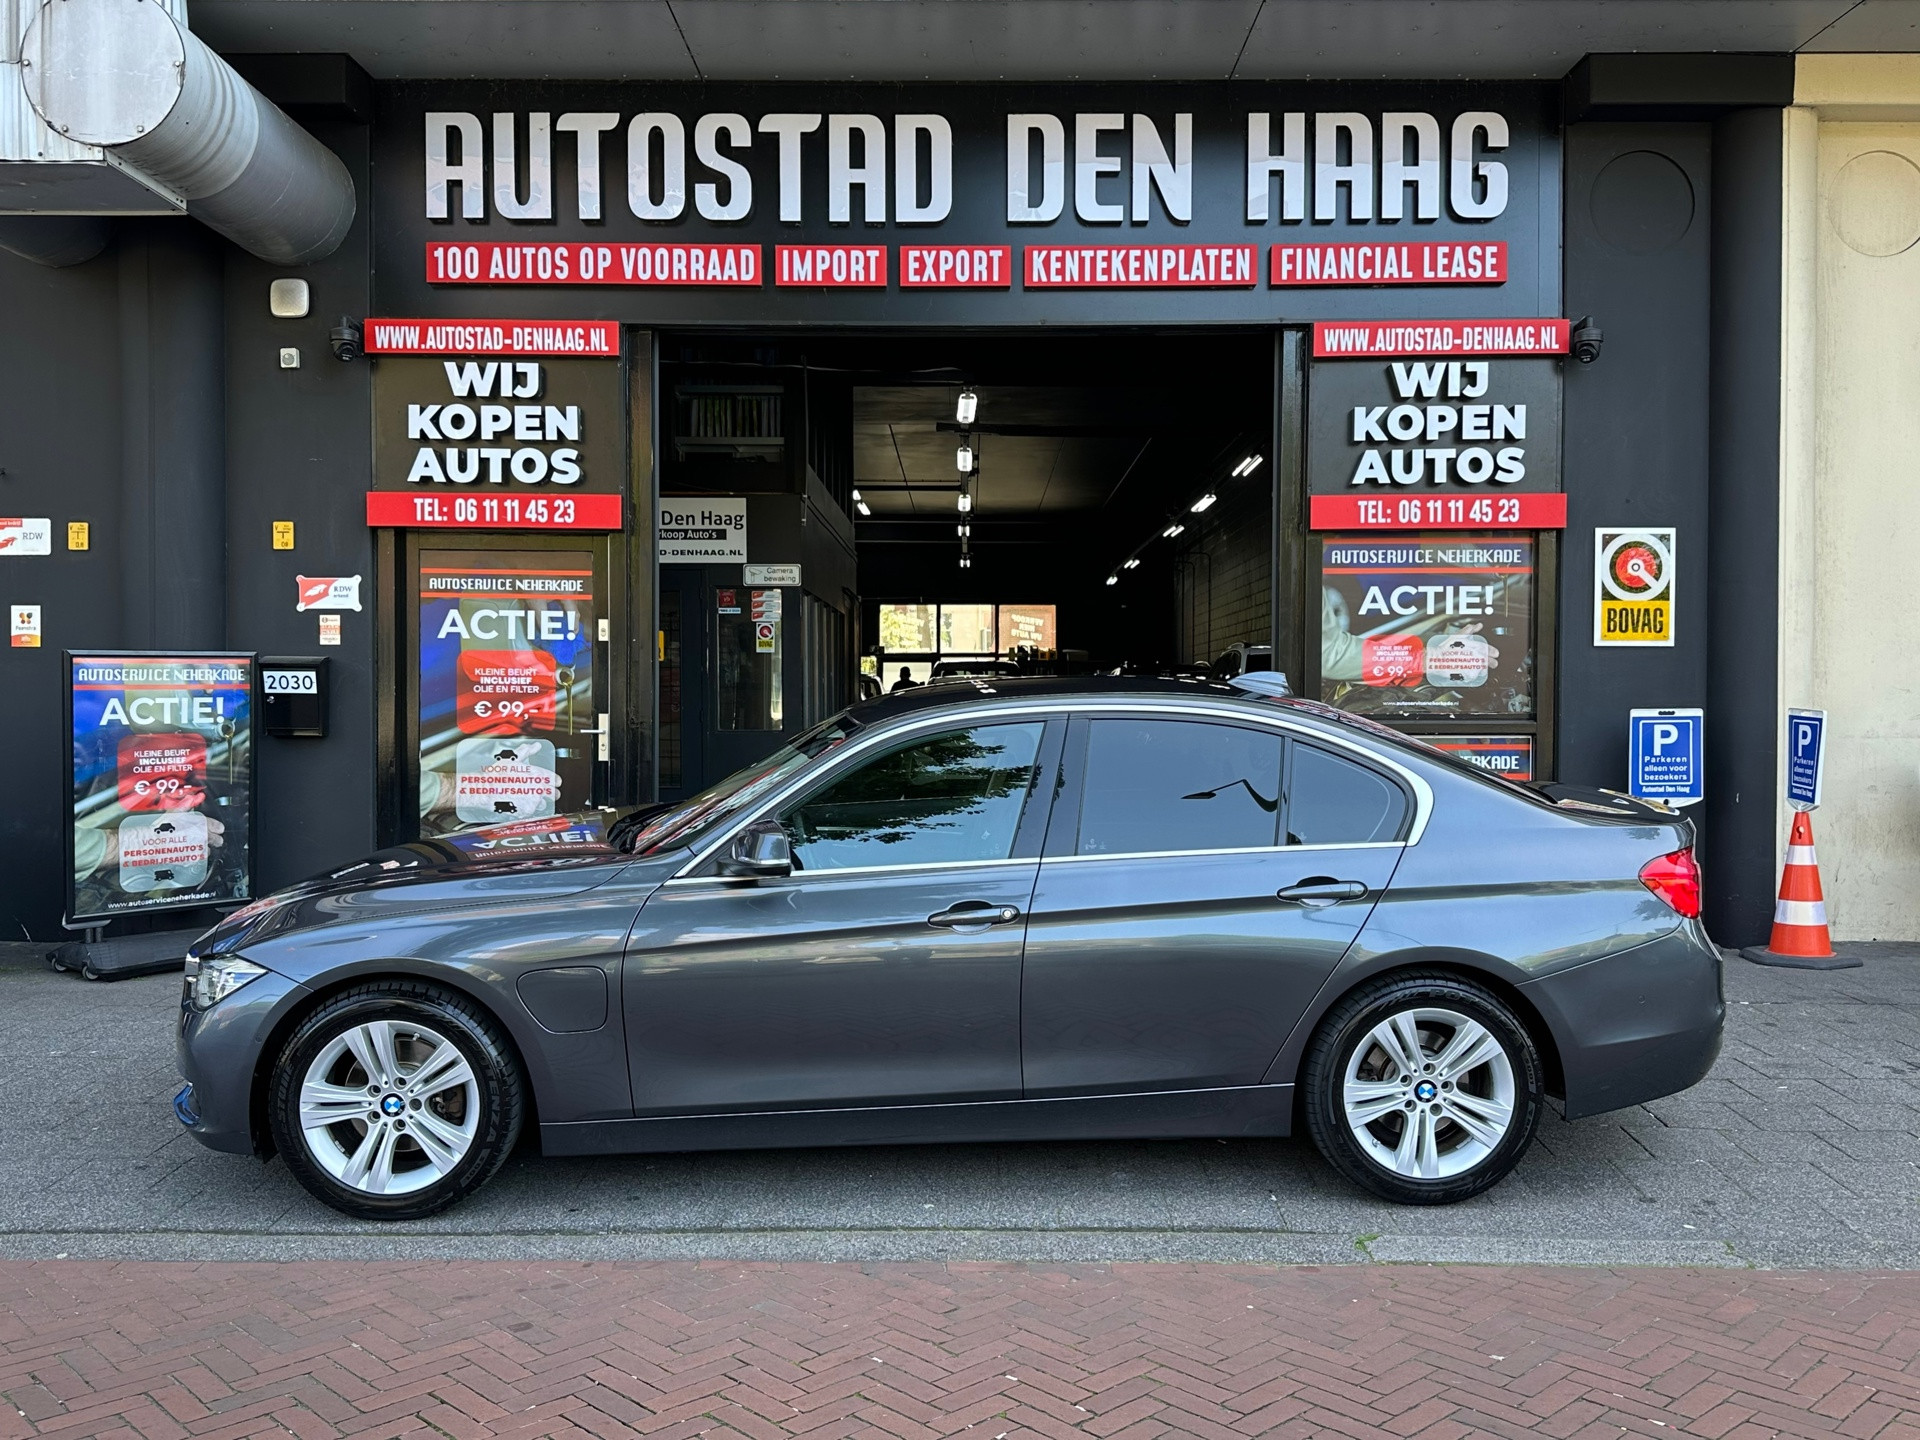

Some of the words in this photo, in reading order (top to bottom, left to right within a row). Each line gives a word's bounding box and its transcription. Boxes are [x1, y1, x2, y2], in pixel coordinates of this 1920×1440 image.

[425, 112, 953, 222] AUTOSTAD
[1007, 112, 1193, 222] DEN
[1246, 111, 1510, 222] HAAG
[433, 248, 480, 279] 100
[489, 248, 570, 280] AUTOS
[580, 248, 613, 280] OP
[621, 249, 756, 282] VOORRAAD
[782, 249, 880, 282] IMPORT
[908, 250, 1003, 283] EXPORT
[1032, 248, 1251, 283] KENTEKENPLATEN
[1281, 247, 1413, 280] FINANCIAL
[1423, 245, 1498, 279] LEASE
[374, 326, 609, 351] WWW.AUTOSTAD-DENHAAG.NL
[1324, 326, 1559, 352] WWW.AUTOSTAD-DENHAAG.NL
[444, 362, 540, 398] WIJ
[1391, 362, 1489, 397] WIJ
[408, 403, 579, 441] KOPEN
[1353, 404, 1527, 441] KOPEN
[407, 447, 581, 484] AUTOS
[1351, 447, 1526, 485] AUTOS
[414, 498, 448, 521] TEL:
[455, 499, 478, 522] 06
[483, 498, 498, 522] 11
[504, 499, 519, 522] 11
[525, 499, 549, 523] 45
[553, 500, 575, 523] 23
[661, 510, 696, 526] Den
[700, 510, 745, 530] Haag
[1358, 500, 1391, 523] TEL:
[1398, 499, 1421, 523] 06
[1426, 500, 1442, 523] 11
[1448, 500, 1464, 523] 11
[1469, 499, 1492, 523] 45
[1498, 499, 1520, 522] 23
[22, 532, 43, 540] RDW
[687, 529, 717, 539] Auto's
[1331, 549, 1434, 564] AUTOSERVICE
[1437, 549, 1522, 564] NEHERKADE
[429, 578, 513, 591] AUTOSERVICE
[515, 579, 584, 592] NEHERKADE
[763, 575, 797, 583] bewaking
[1358, 585, 1495, 616] ACTIE!
[437, 608, 577, 641] ACTIE!
[1606, 607, 1664, 634] BOVAG
[79, 668, 171, 682] AUTOSERVICE
[173, 668, 245, 682] NEHERKADE
[474, 668, 506, 677] KLEINE
[507, 668, 538, 677] BEURT
[480, 676, 532, 685] INCLUSIEF
[1373, 666, 1384, 676] €
[1387, 665, 1412, 677] 99,-
[266, 674, 314, 690] 2030
[473, 685, 495, 694] OLIE
[496, 685, 509, 694] EN
[510, 685, 539, 694] FILTER
[100, 697, 224, 726] ACTIE!
[474, 701, 492, 718] €
[498, 701, 538, 720] 99,-
[1653, 724, 1678, 756] P
[1798, 724, 1812, 757] P
[134, 750, 162, 758] KLEINE
[164, 749, 191, 757] BEURT
[139, 757, 186, 765] INCLUSIEF
[1644, 755, 1687, 763] Parkeren
[133, 765, 152, 773] OLIE
[154, 765, 166, 773] EN
[167, 764, 193, 773] FILTER
[481, 765, 508, 773] VOOR
[510, 765, 531, 773] ALLE
[134, 780, 151, 796] €
[155, 779, 192, 796] 99,-
[461, 776, 551, 785] PERSONENAUTO'S
[459, 787, 467, 795] &
[469, 787, 552, 796] BEDRIJFSAUTO'S
[142, 837, 167, 846] VOOR
[168, 835, 187, 844] ALLE
[123, 844, 204, 857] PERSONENAUTO'S
[131, 854, 205, 867] BEDRIJFSAUTO'S
[107, 891, 217, 909] www.autoserviceneherkade.nl
